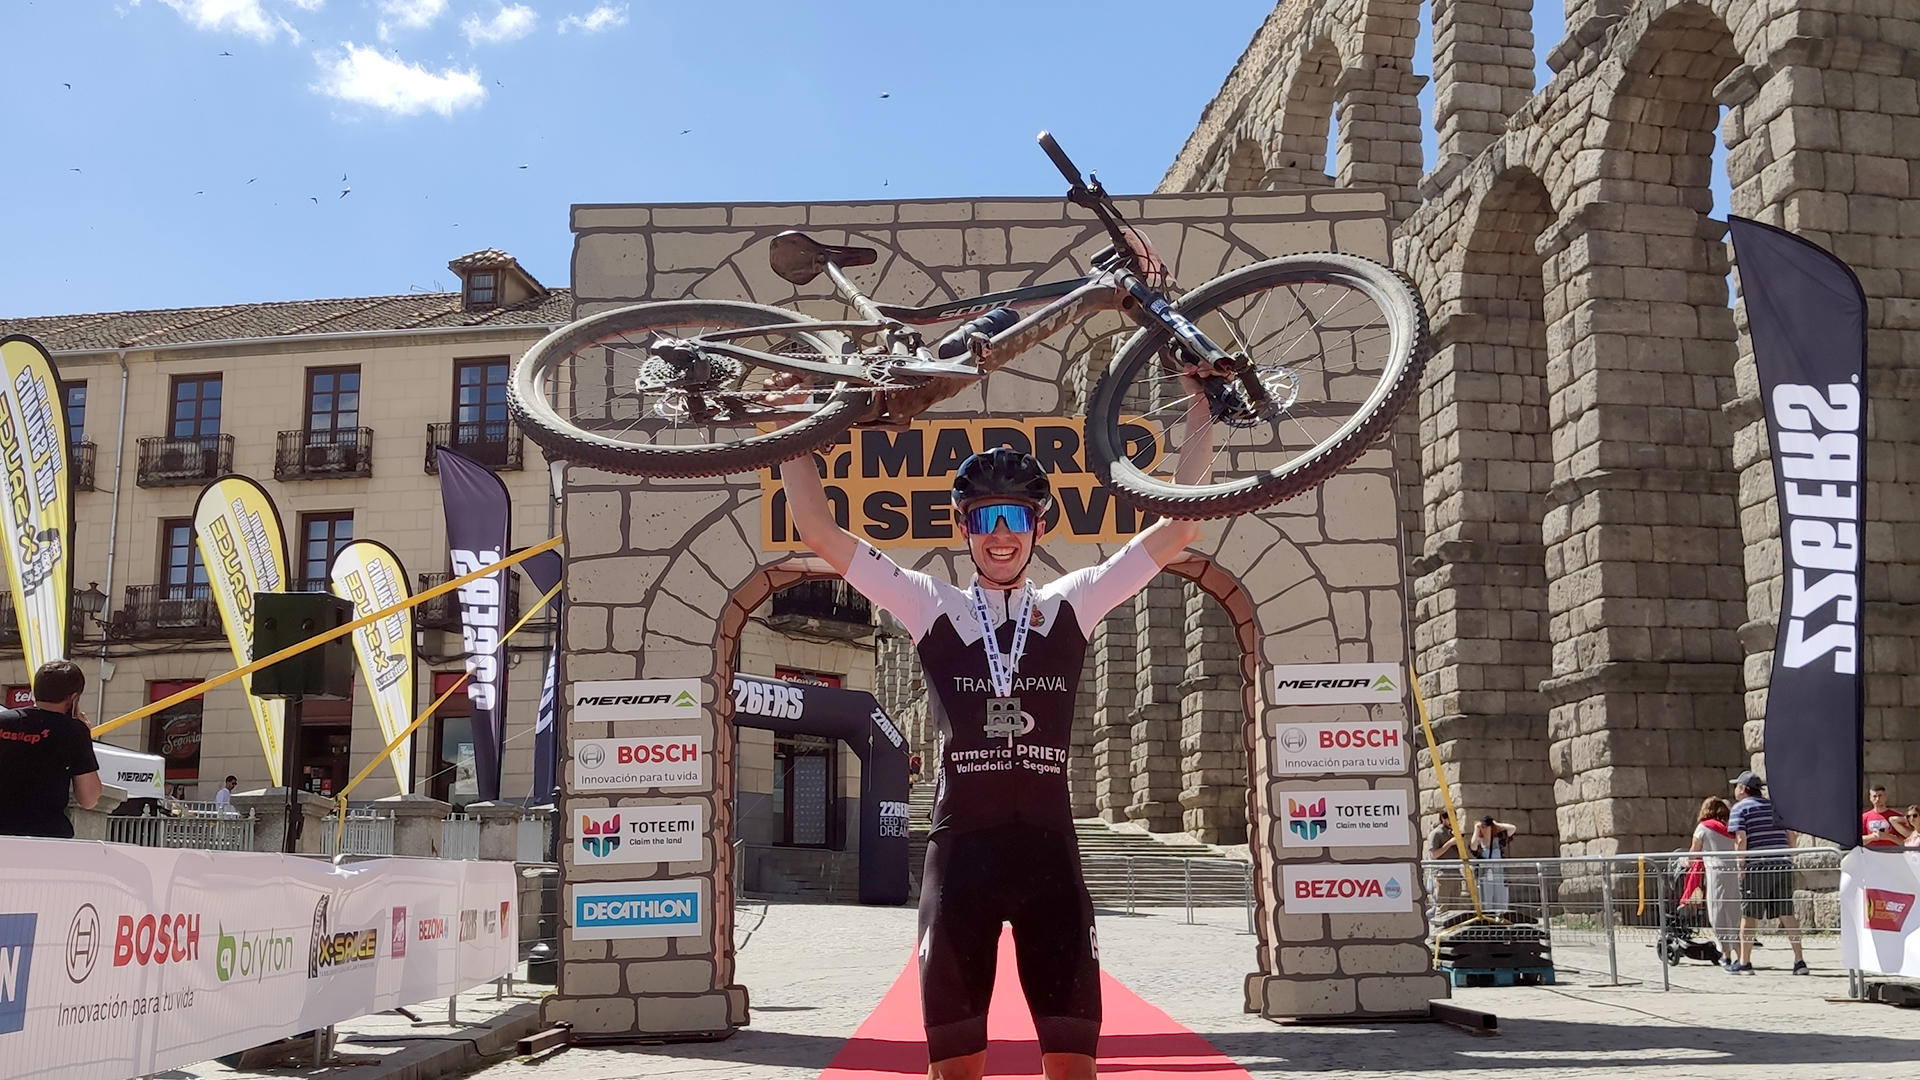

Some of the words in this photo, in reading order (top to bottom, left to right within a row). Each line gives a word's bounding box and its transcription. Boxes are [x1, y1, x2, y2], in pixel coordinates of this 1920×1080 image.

[938, 298, 1018, 319] SCOTT
[953, 676, 1068, 692] TRANAPAVAL
[1277, 678, 1370, 690] MERIDA
[577, 694, 672, 706] MERIDA
[729, 679, 804, 720] 26ERS
[870, 707, 903, 749] 226ERS
[161, 731, 201, 755] Segovia
[1319, 729, 1398, 749] BOSCH
[618, 743, 697, 764] BOSCH
[1016, 744, 1066, 763] PRIETO
[956, 760, 1012, 774] Valladolid
[1022, 759, 1061, 774] Segovia
[1284, 758, 1340, 768] Innovación
[1342, 759, 1365, 769] para
[1366, 758, 1377, 766] tu
[1378, 757, 1400, 766] vida
[117, 771, 153, 783] MERIDA
[581, 773, 638, 784] Innovación
[640, 775, 662, 784] para
[664, 773, 675, 781] tu
[677, 771, 698, 781] vida
[1335, 804, 1400, 817] TOTEEMI
[629, 820, 695, 833] TOTEEMI
[880, 817, 899, 826] FEED
[1335, 821, 1356, 829] Claim
[629, 838, 650, 846] Claim
[652, 837, 664, 845] the
[1295, 879, 1383, 899] BEZOYA
[583, 899, 691, 921] DECATHLON
[113, 913, 200, 967] BOSCH
[240, 927, 293, 984] bryton
[57, 993, 125, 1027] Innovación
[131, 996, 160, 1022] para
[163, 991, 173, 1012] tu
[176, 986, 194, 1010] vida
